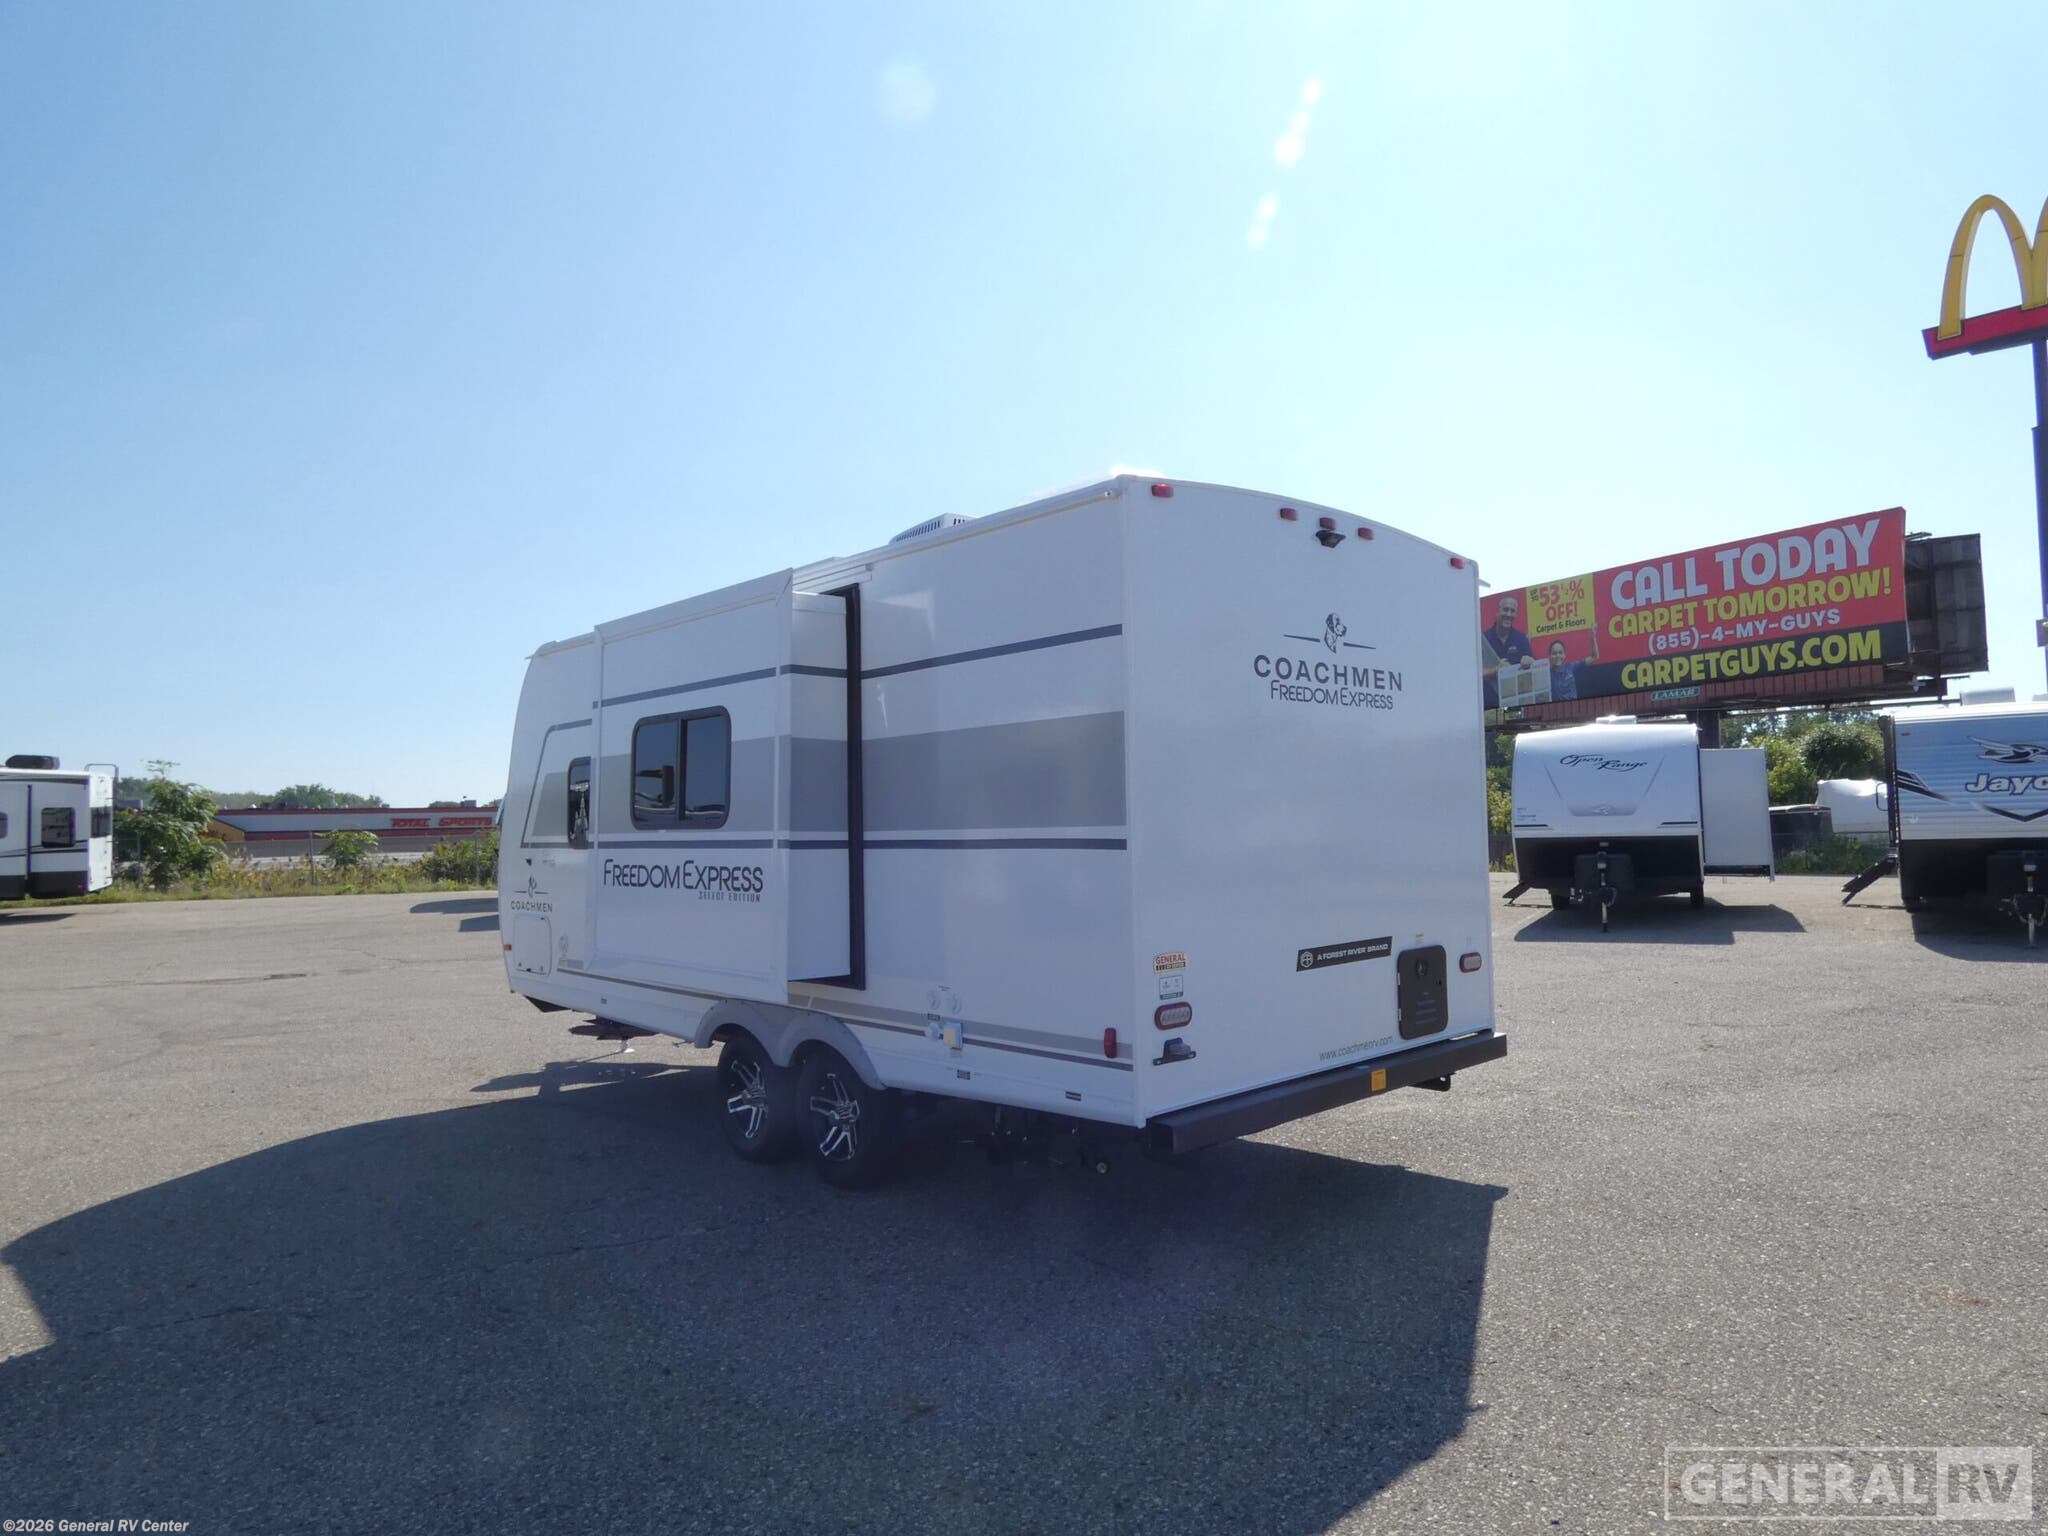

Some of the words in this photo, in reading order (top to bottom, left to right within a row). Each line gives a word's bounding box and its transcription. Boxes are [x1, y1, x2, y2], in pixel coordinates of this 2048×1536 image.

[1611, 557, 1710, 610] CALL
[1715, 518, 1881, 598] TODAY
[1546, 600, 1578, 621] OFF!
[1609, 602, 1695, 639] CARPET
[1706, 567, 1892, 622] TOMORROW!
[1536, 623, 1557, 633] Carpet
[1558, 621, 1564, 629] &
[1565, 618, 1586, 628] Floors
[1648, 608, 1841, 654] (855)-4-MY-GUYS
[1621, 629, 1881, 690] CARPETGUYS.COM
[1254, 654, 1403, 692] COACHMEN
[1655, 688, 1696, 700] LAMAR
[1560, 754, 1604, 767] Open
[1598, 761, 1648, 772] Range
[698, 890, 724, 900] SELECT
[728, 892, 761, 903] EDITION
[510, 900, 553, 913] COACHMEN
[1156, 953, 1186, 965] GENERAL
[1317, 953, 1323, 961] A
[1323, 951, 1347, 960] FOREST
[1347, 947, 1366, 956] RIVER
[1367, 944, 1389, 953] BRAND
[1319, 1037, 1394, 1061] www.coachmenrv.com
